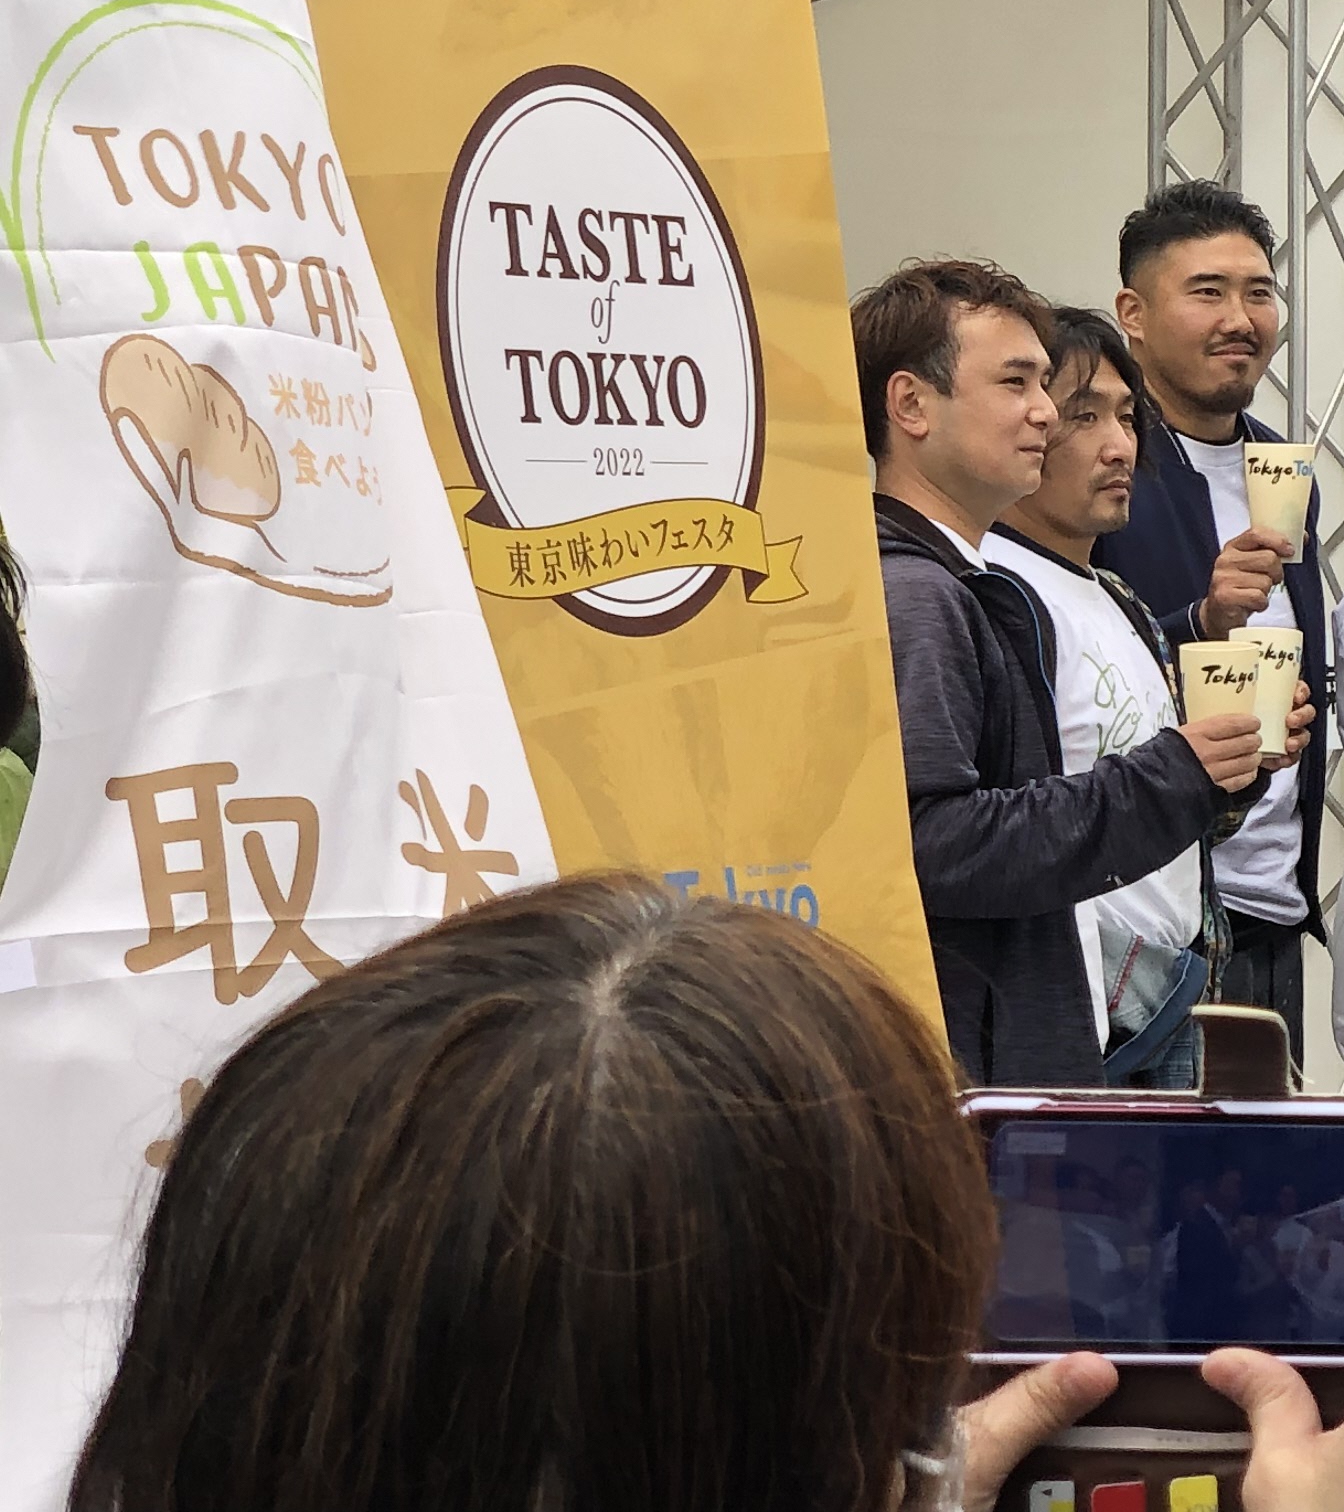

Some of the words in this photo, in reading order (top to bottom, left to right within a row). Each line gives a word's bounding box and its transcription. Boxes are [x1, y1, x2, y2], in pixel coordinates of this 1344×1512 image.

[489, 200, 695, 288] TASTE
[591, 280, 620, 343] of
[505, 348, 707, 429] TOKYO
[593, 448, 645, 477] 2022
[1248, 457, 1293, 484] Tokyo
[506, 513, 734, 587] 東京味わいフェスタ
[1201, 665, 1254, 693] Tokyo
